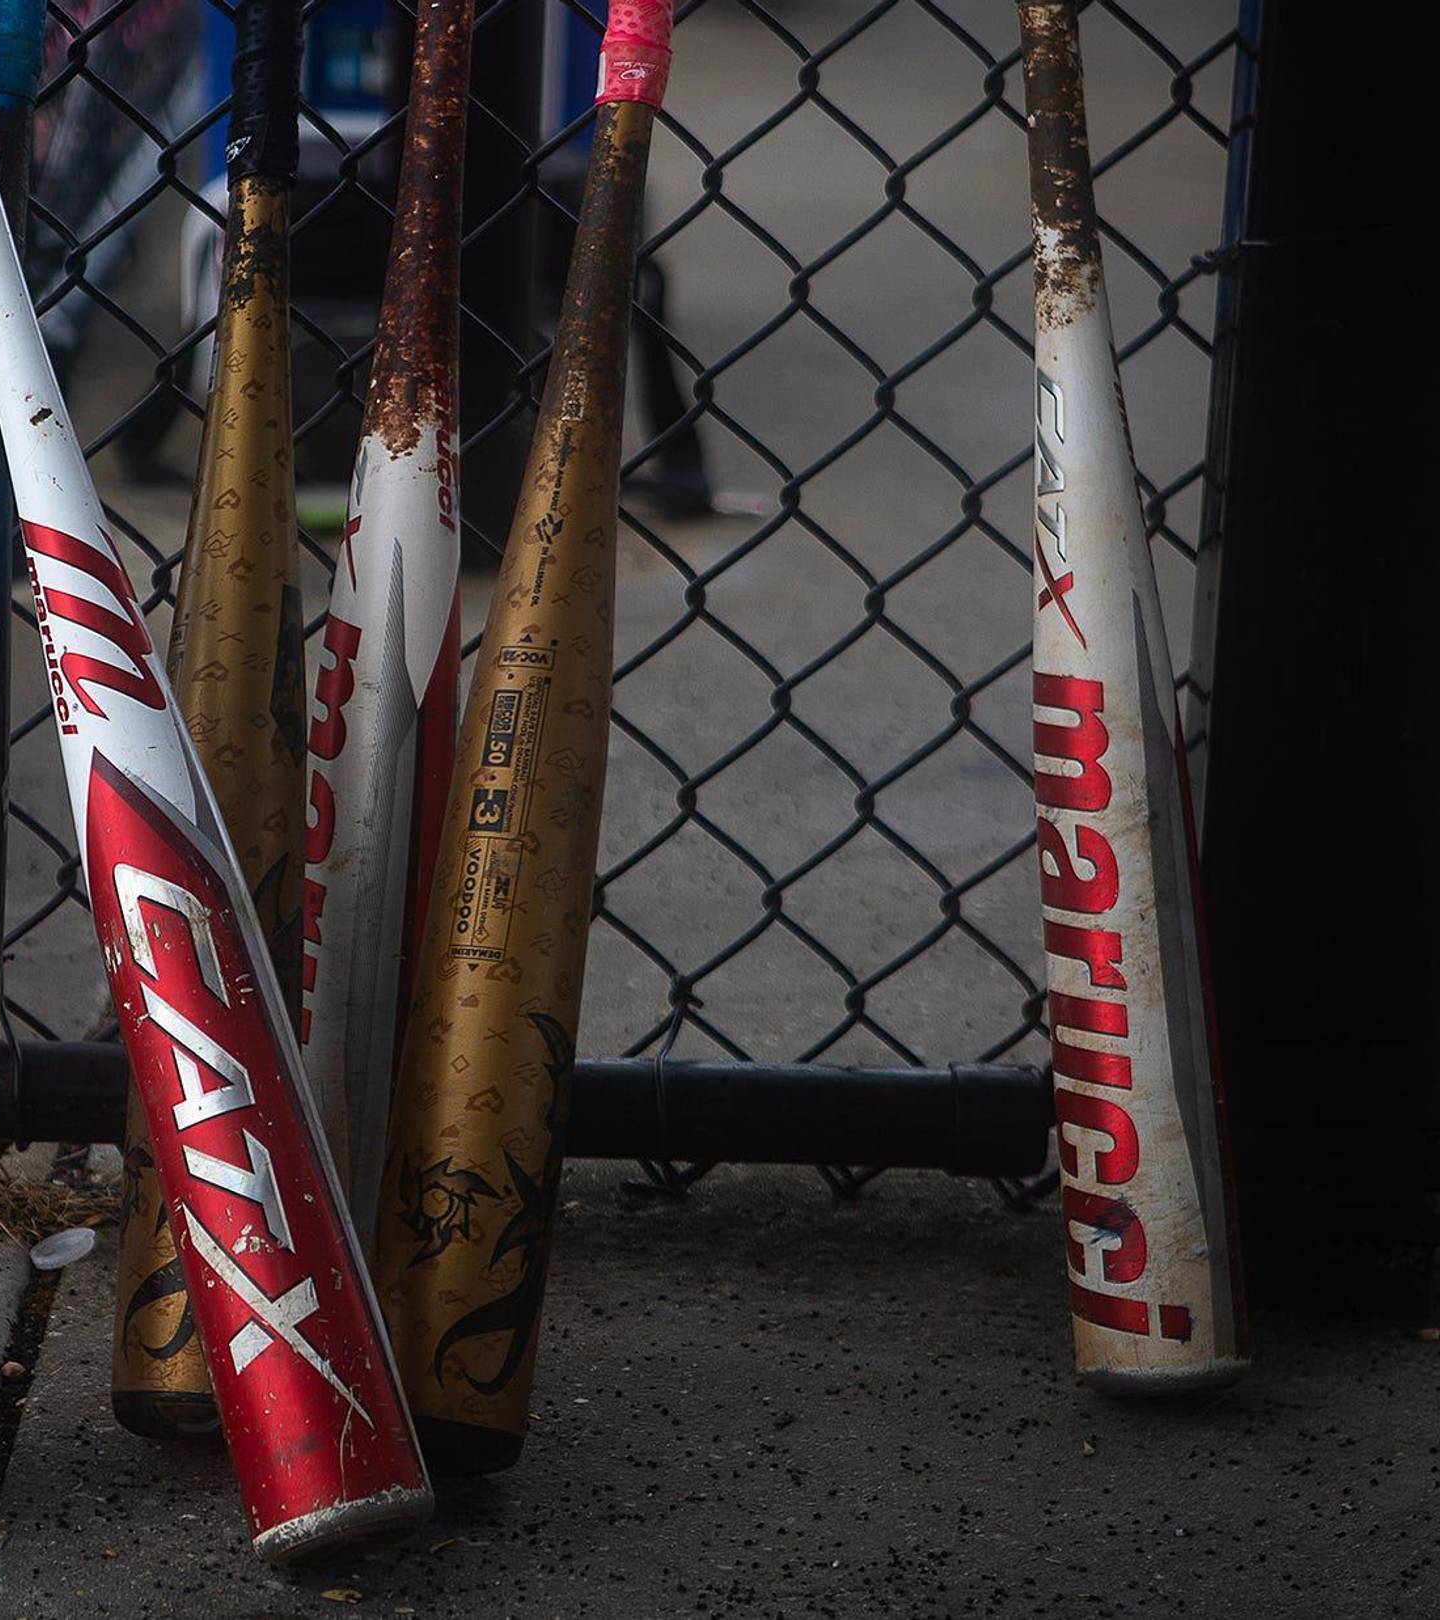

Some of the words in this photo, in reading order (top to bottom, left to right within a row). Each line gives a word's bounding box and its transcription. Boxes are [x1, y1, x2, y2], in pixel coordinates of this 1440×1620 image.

[26, 556, 79, 735] marucci
[475, 788, 501, 824] -3
[488, 735, 507, 764] .50
[458, 849, 481, 932] VOODOO
[1033, 672, 1193, 1343] marucci
[114, 863, 375, 1430] CATX
